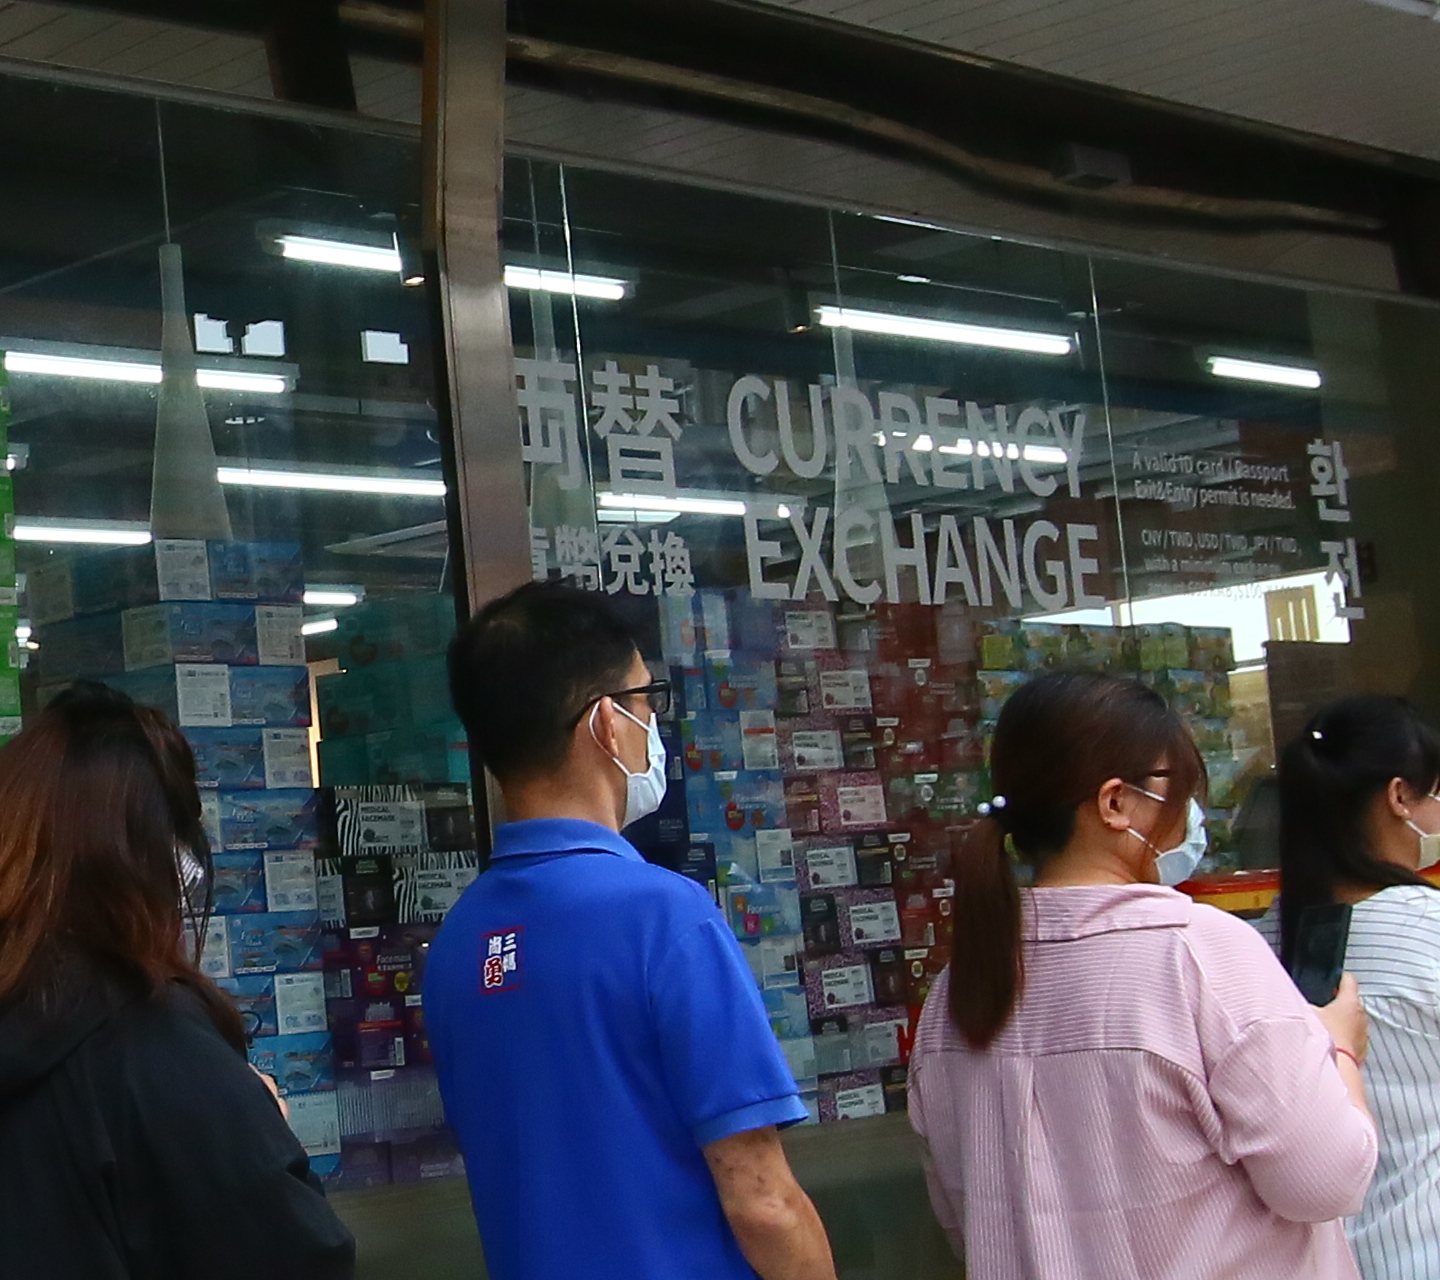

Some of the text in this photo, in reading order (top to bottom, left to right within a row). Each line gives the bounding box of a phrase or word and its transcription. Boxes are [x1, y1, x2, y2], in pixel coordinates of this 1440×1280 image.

[727, 373, 1086, 499] CURRENCY
[1133, 454, 1143, 471] A
[1144, 454, 1177, 472] valid
[1195, 457, 1224, 475] card
[742, 503, 1107, 611] EXCHANGE
[1307, 438, 1365, 620] 환전
